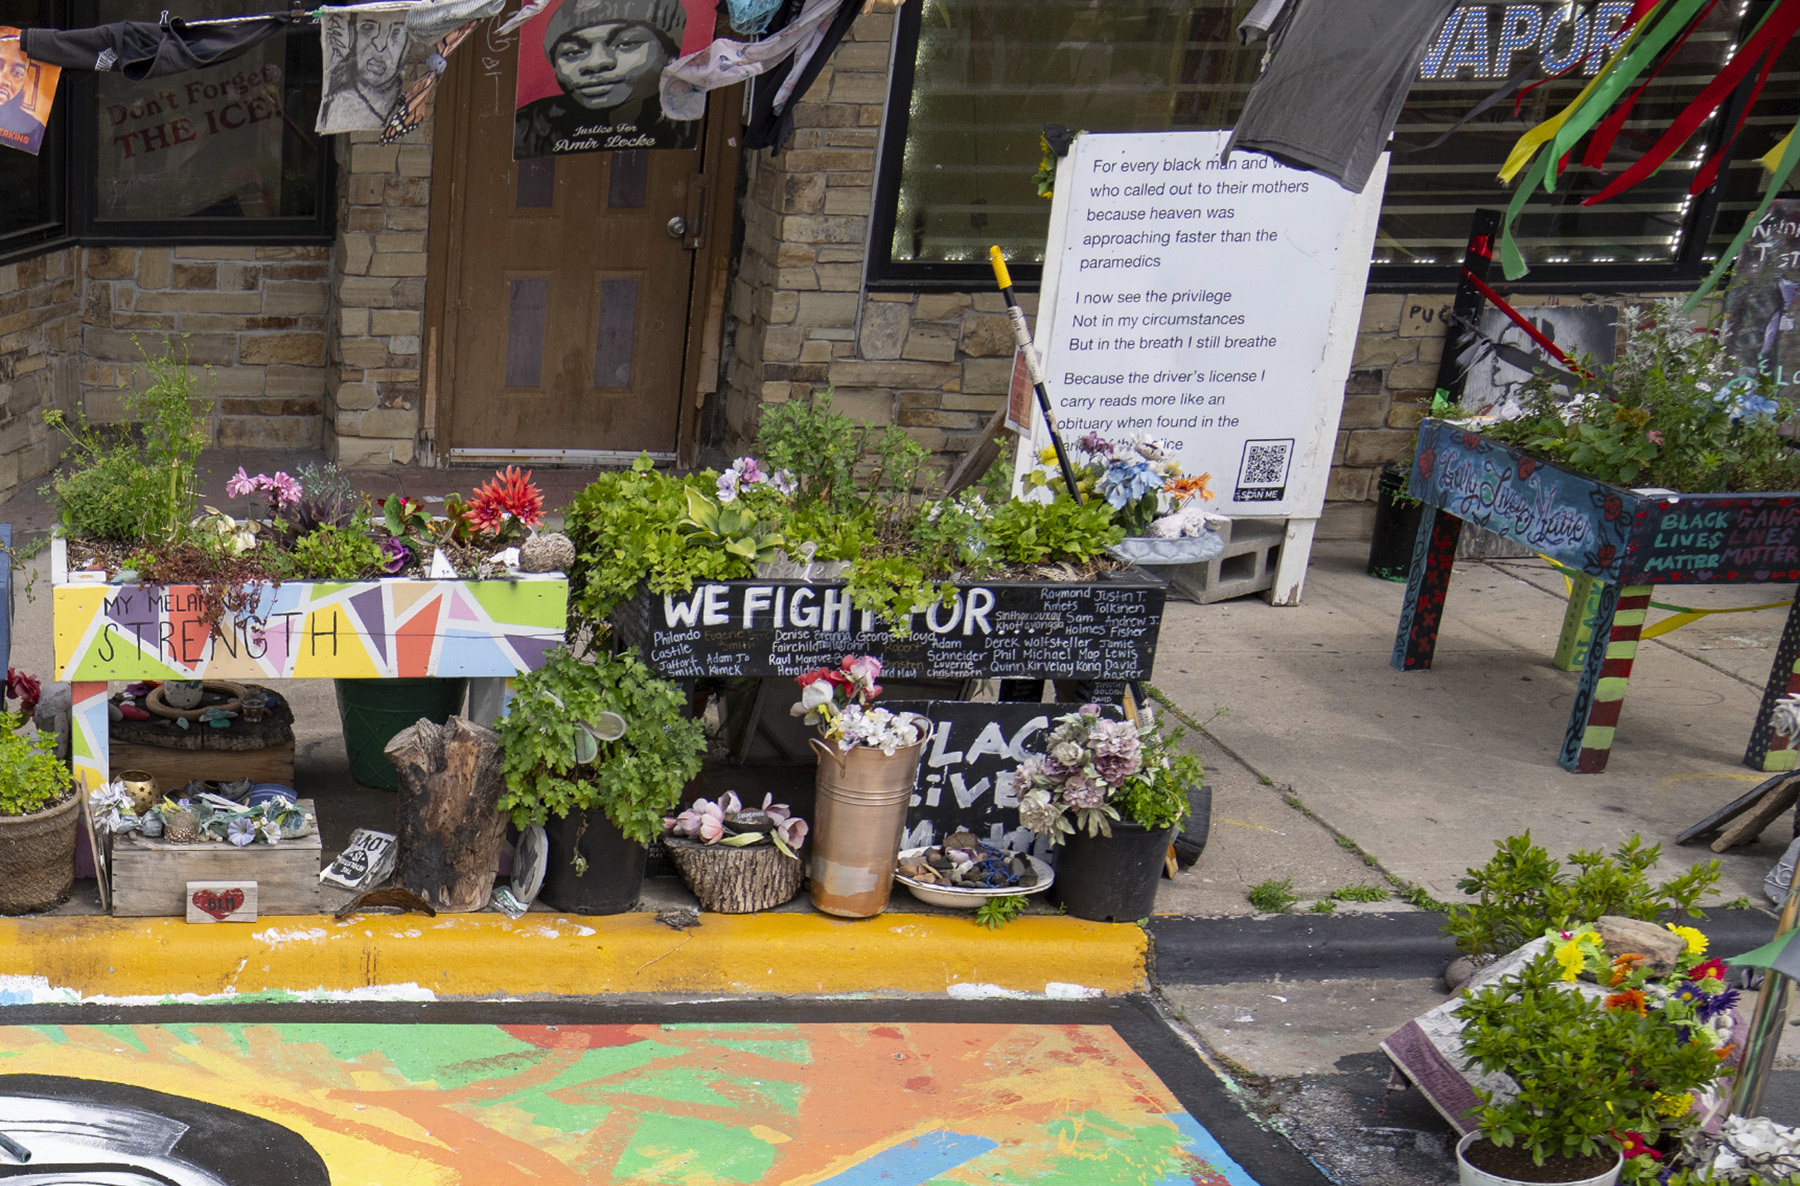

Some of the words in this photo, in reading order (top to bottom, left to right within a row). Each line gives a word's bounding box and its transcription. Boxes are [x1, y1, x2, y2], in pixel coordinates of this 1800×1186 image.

[184, 64, 276, 105] Forget
[114, 116, 197, 159] THE
[204, 97, 284, 136] ICE!
[573, 123, 614, 137] Justice
[616, 122, 638, 134] For
[552, 137, 600, 152] Amir
[604, 134, 657, 149] Locke
[1093, 159, 1118, 174] For
[1120, 160, 1159, 175] every
[1163, 157, 1201, 172] black
[1241, 156, 1269, 170] and
[1090, 184, 1120, 197] who
[1124, 183, 1166, 197] called
[1169, 183, 1192, 196] out
[1198, 182, 1212, 195] to
[1216, 180, 1249, 195] their
[1252, 180, 1310, 194] mothers
[1086, 208, 1146, 222] because
[1149, 207, 1201, 220] heaven
[1206, 208, 1236, 219] was
[1083, 230, 1171, 249] approaching
[1175, 230, 1217, 243] faster
[1220, 229, 1251, 243] than
[1255, 229, 1278, 242] the
[1079, 255, 1161, 272] paramedics
[1084, 292, 1114, 304] now
[1117, 292, 1141, 304] see
[1145, 290, 1168, 303] the
[1171, 290, 1232, 305] privilege
[1072, 315, 1097, 328] Not
[1101, 314, 1114, 327] in
[1118, 315, 1139, 329] my
[1142, 312, 1246, 327] circumstances
[1069, 338, 1094, 351] But
[1098, 338, 1110, 350] in
[1113, 337, 1135, 350] the
[1139, 336, 1183, 350] breath
[1196, 335, 1220, 349] still
[1224, 335, 1277, 348] breathe
[1064, 371, 1125, 386] Because
[1128, 371, 1150, 384] the
[1208, 369, 1258, 383] license
[1060, 396, 1096, 410] carry
[1099, 394, 1137, 407] reads
[1141, 393, 1176, 405] more
[1180, 392, 1204, 405] like
[1208, 393, 1226, 405] an
[1057, 416, 1113, 431] obituary
[1117, 416, 1153, 428] when
[1156, 415, 1197, 428] found
[1201, 415, 1214, 428] in
[1218, 415, 1240, 428] the
[1240, 490, 1263, 499] SCAN
[1265, 490, 1278, 499] ME
[1660, 511, 1730, 530] BLACK
[1654, 531, 1725, 550] LIVES
[1727, 527, 1796, 546] LIVES
[1643, 553, 1721, 572] MATTER
[1719, 545, 1800, 565] MATTER
[1040, 587, 1092, 600] Raymond
[1093, 590, 1133, 602] Justin
[1136, 590, 1148, 602] T.
[104, 595, 135, 616] MY
[663, 584, 730, 628] WE
[900, 587, 995, 636] OR
[1066, 611, 1094, 623] Sam
[1105, 615, 1147, 626] Andrew
[98, 610, 338, 662] STRENGTH
[775, 629, 810, 642] Denise
[1065, 624, 1106, 636] Holmes
[1111, 625, 1147, 637] Fisher
[653, 629, 701, 647] Philando
[856, 631, 898, 645] George
[932, 638, 962, 649] Adam
[1099, 638, 1135, 649] Jamie
[651, 643, 693, 661] Castile
[771, 640, 819, 653] Fairchild
[1104, 648, 1139, 659] Lewis
[706, 652, 733, 664] Adam
[769, 653, 791, 666] Raul
[927, 649, 988, 662] Schneider
[993, 649, 1016, 661] Phil
[1022, 649, 1072, 660] Michael
[668, 664, 705, 677] Smith
[989, 661, 1026, 674] Quinn
[1076, 661, 1102, 678] Kong
[1104, 659, 1138, 670] David
[927, 668, 983, 678] Christensen
[208, 897, 236, 912] BLM
